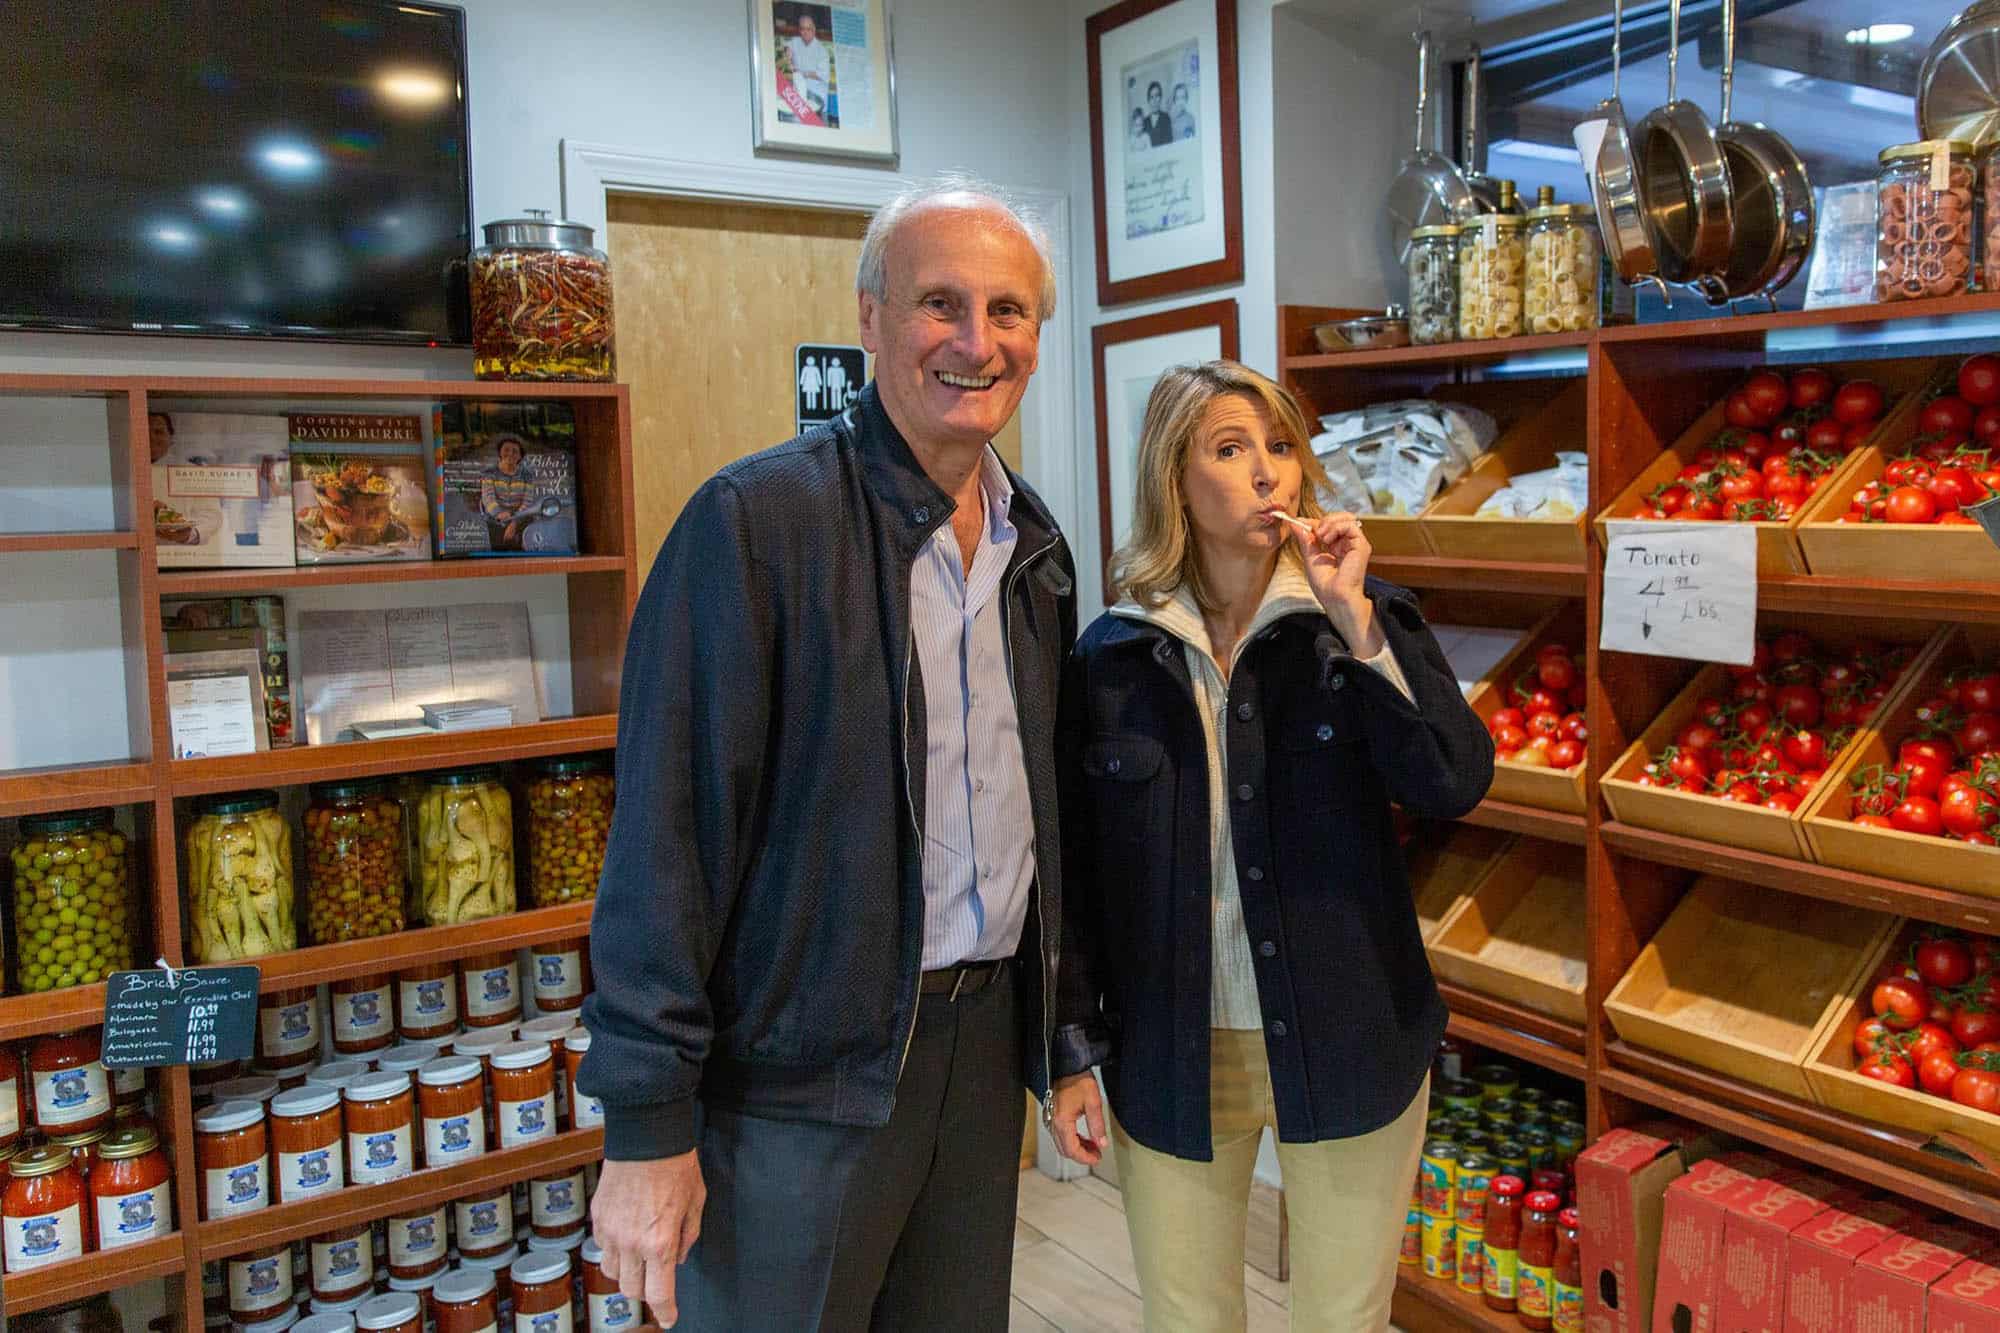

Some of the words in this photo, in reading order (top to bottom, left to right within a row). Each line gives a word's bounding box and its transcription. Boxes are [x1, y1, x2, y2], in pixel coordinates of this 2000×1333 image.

[296, 415, 366, 426] COOKING
[377, 418, 413, 427] WITH
[296, 426, 351, 439] DAVID
[358, 427, 415, 441] BURKE
[1624, 546, 1701, 567] Tomato
[187, 1019, 215, 1033] 11.99
[188, 1034, 217, 1048] 11.99
[186, 1047, 217, 1062] 11.99
